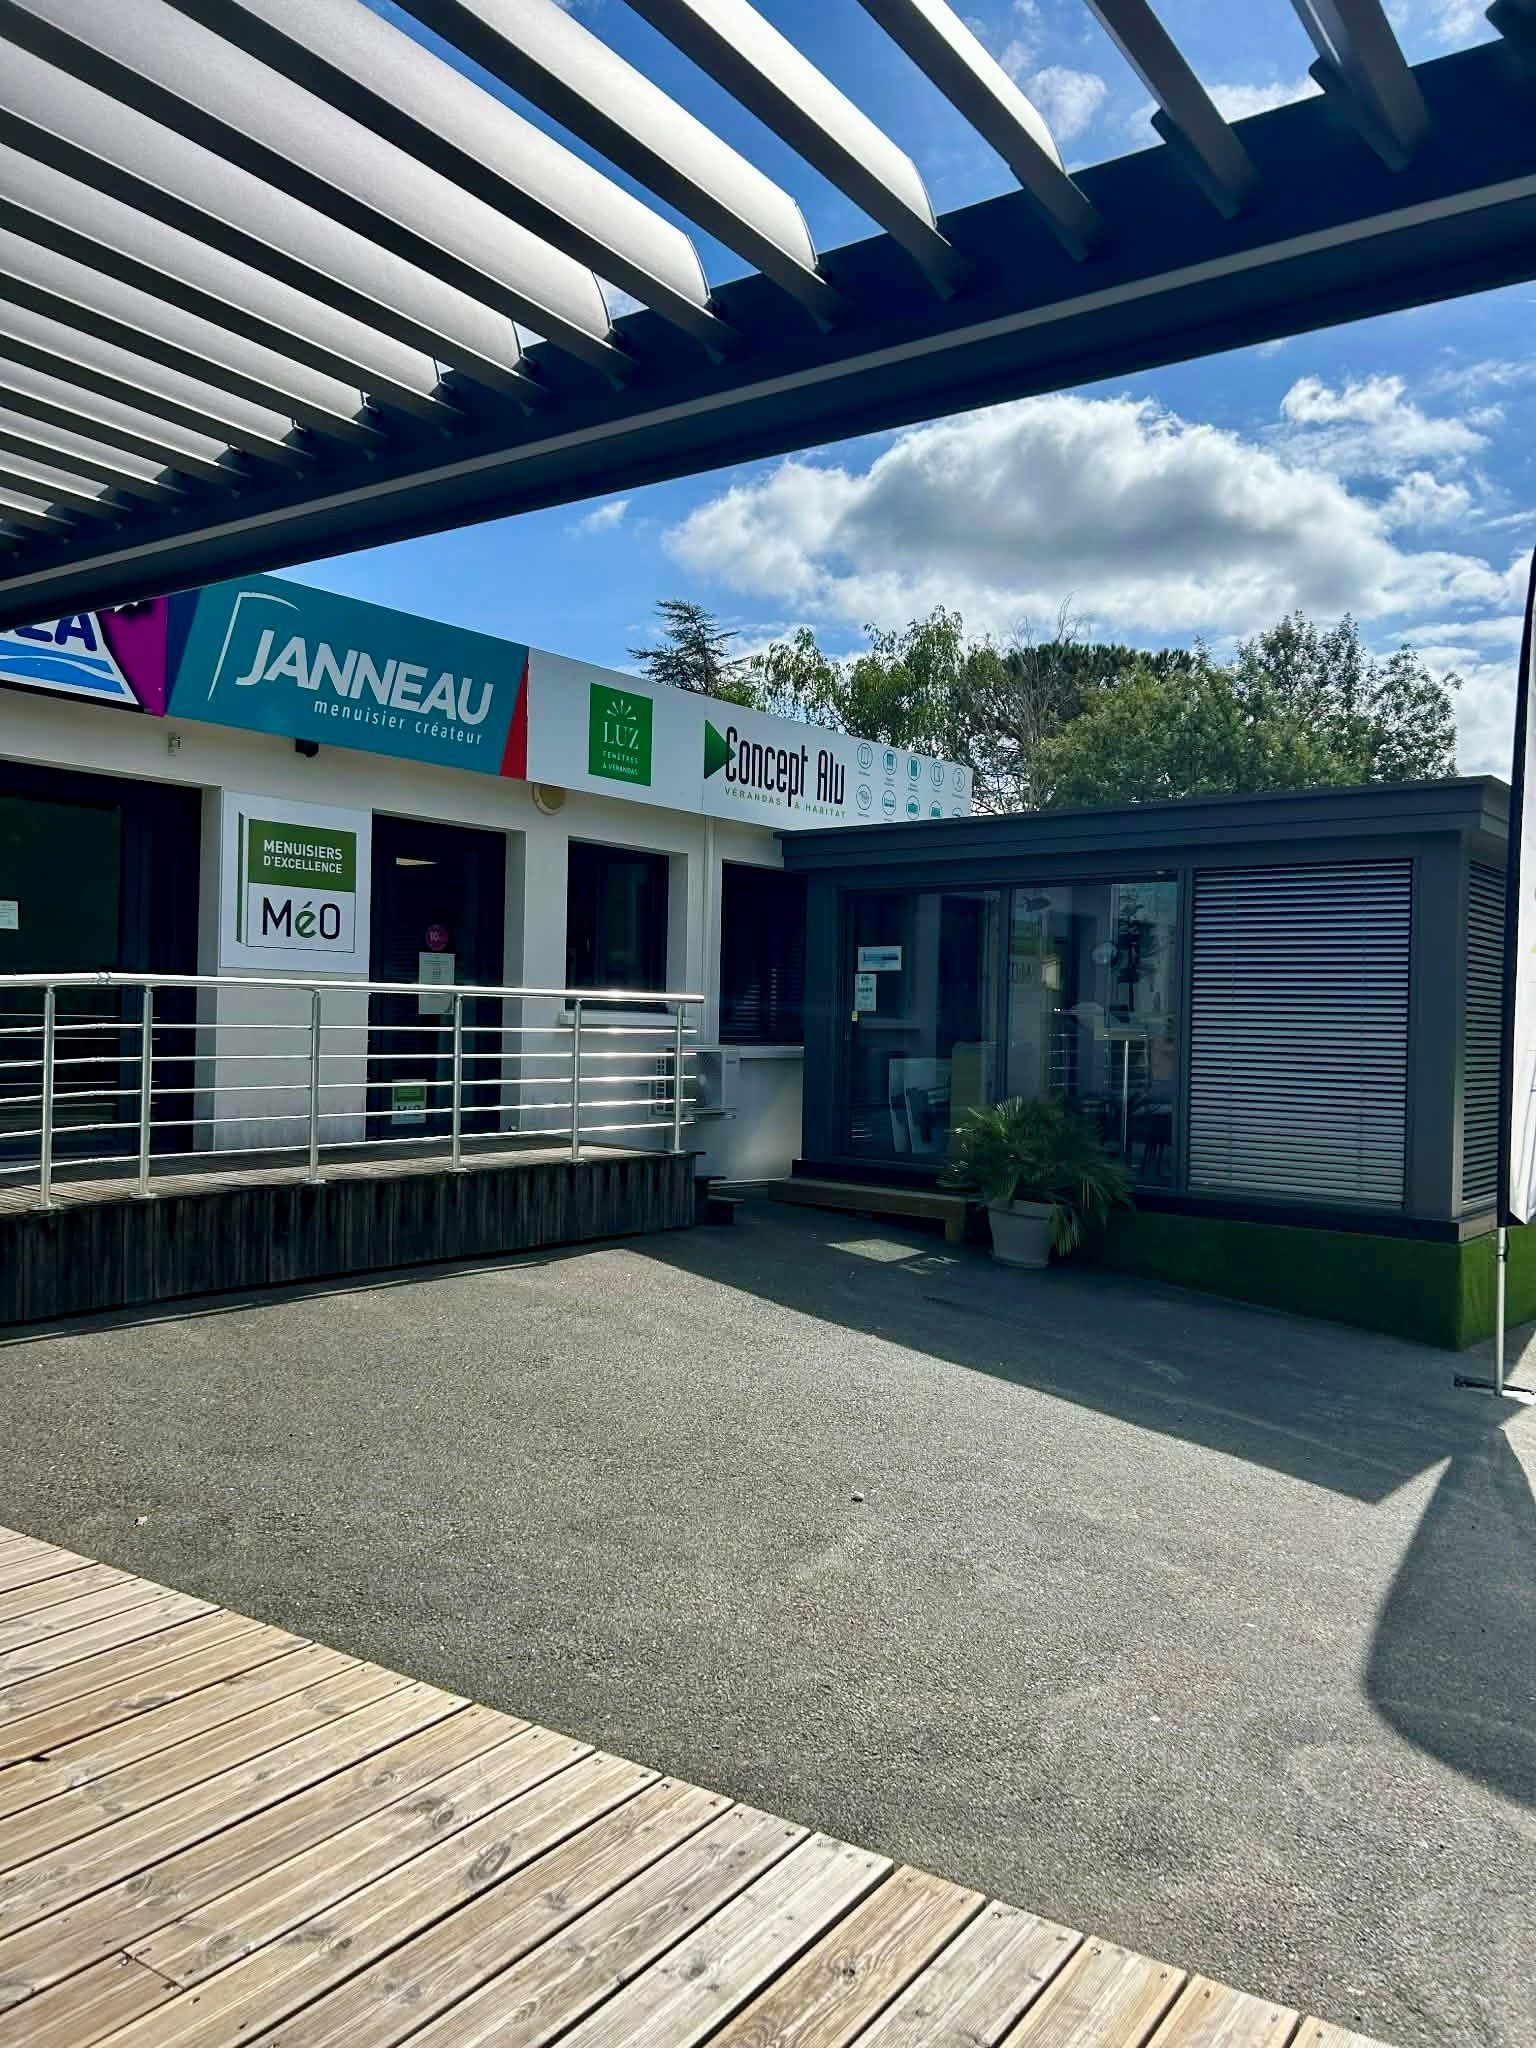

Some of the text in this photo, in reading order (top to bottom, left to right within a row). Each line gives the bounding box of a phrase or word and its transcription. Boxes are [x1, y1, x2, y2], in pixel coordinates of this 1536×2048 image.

[235, 629, 494, 726] JANNEAU
[314, 700, 483, 745] menuisier créateur
[602, 721, 640, 750] LUZ
[725, 726, 846, 808] Concept Alu
[805, 804, 847, 820] HABITAT
[263, 839, 343, 861] MENUISIERS
[263, 855, 343, 874] D'EXCELLENCE
[262, 897, 341, 940] MéO
